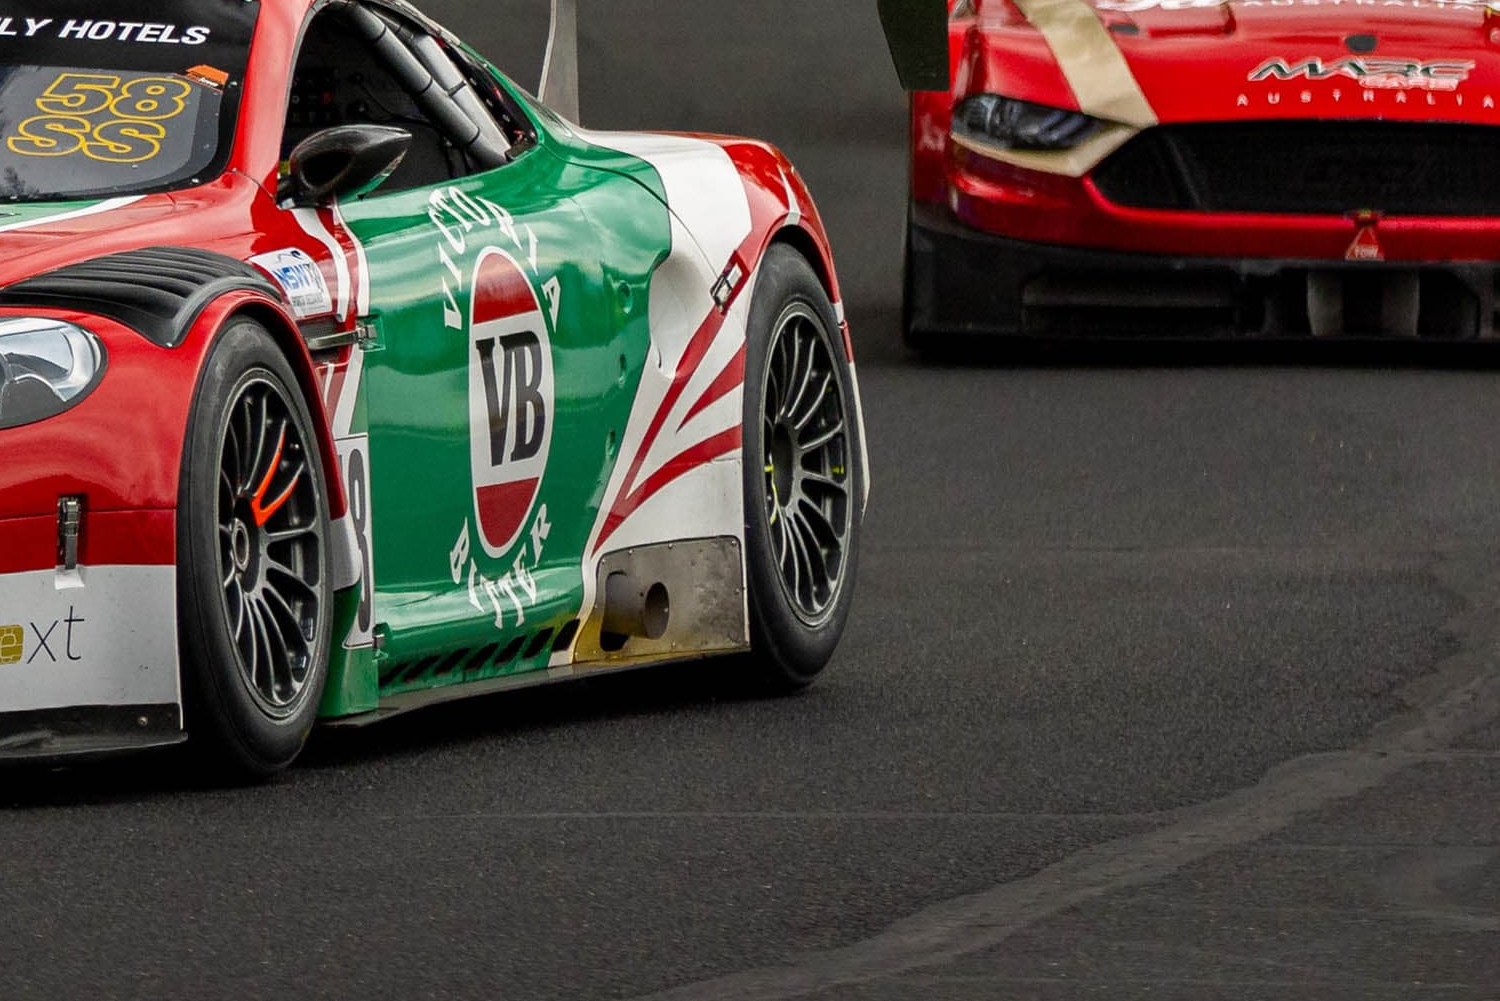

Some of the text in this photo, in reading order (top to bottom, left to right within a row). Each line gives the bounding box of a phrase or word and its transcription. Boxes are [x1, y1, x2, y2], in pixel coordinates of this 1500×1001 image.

[57, 19, 212, 45] HOTELS
[35, 72, 192, 121] 58
[1236, 88, 1495, 109] AUSTRALIA
[7, 114, 166, 164] SS
[474, 330, 547, 468] VB
[449, 502, 552, 630] BITTER
